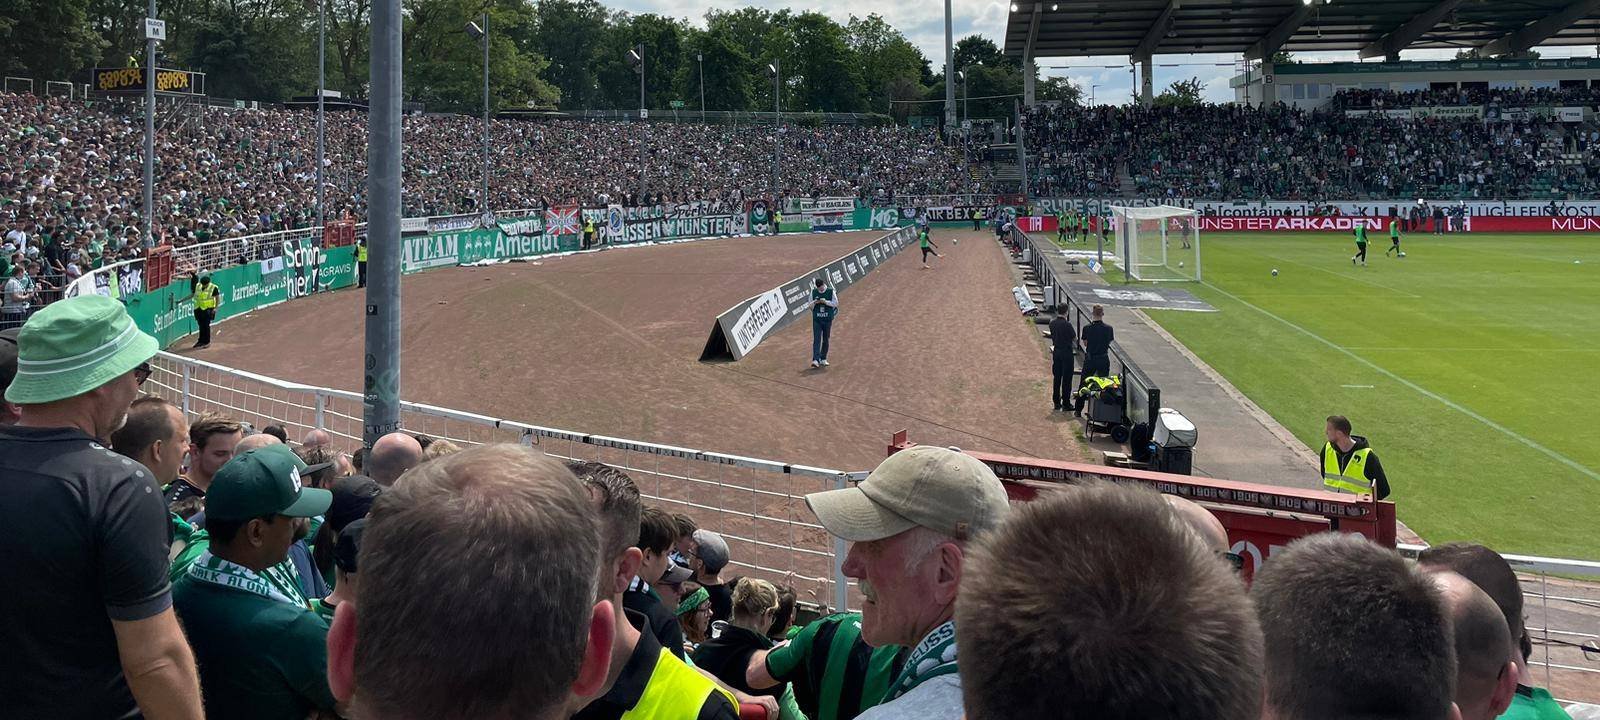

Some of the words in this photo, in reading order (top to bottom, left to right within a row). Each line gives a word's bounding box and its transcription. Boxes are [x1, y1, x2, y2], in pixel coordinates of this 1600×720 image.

[148, 20, 164, 28] BLOCK
[152, 28, 160, 36] M
[1144, 77, 1152, 86] A
[1265, 74, 1274, 84] B
[1041, 199, 1084, 214] RUDE
[676, 217, 732, 236] MÜNSTER
[1274, 217, 1383, 230] ARKADEN
[284, 239, 320, 268] Schön
[318, 263, 352, 279] AGRAVIS
